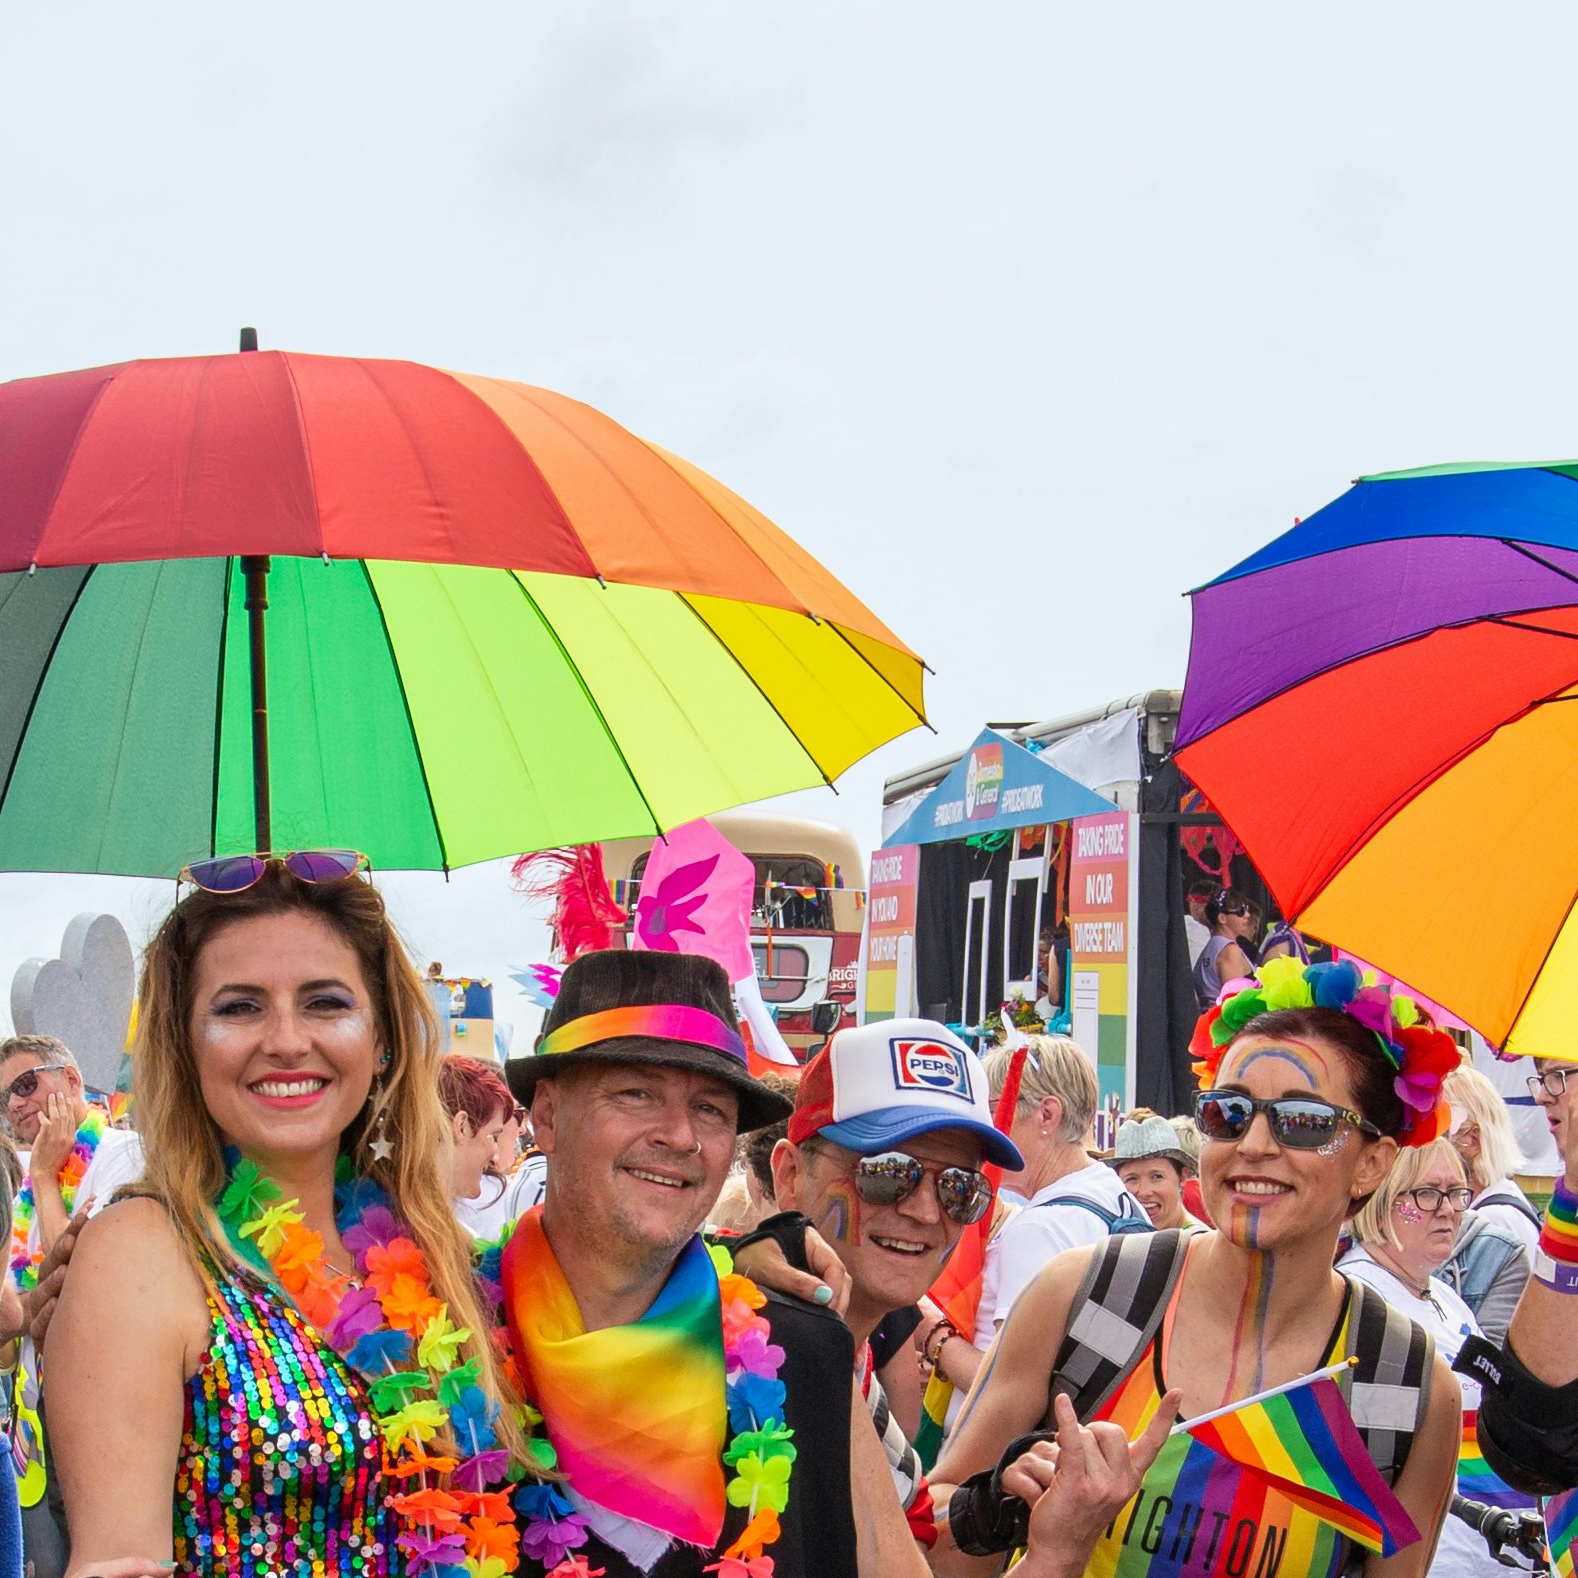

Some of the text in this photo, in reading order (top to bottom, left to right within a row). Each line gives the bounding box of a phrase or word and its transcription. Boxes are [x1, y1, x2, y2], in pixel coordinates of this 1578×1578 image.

[1077, 823, 1124, 857] TAKING PRIDE
[1085, 873, 1113, 905] IN OUR
[1074, 922, 1124, 953] DIVERSE TEAM
[909, 1058, 959, 1078] PEPSI
